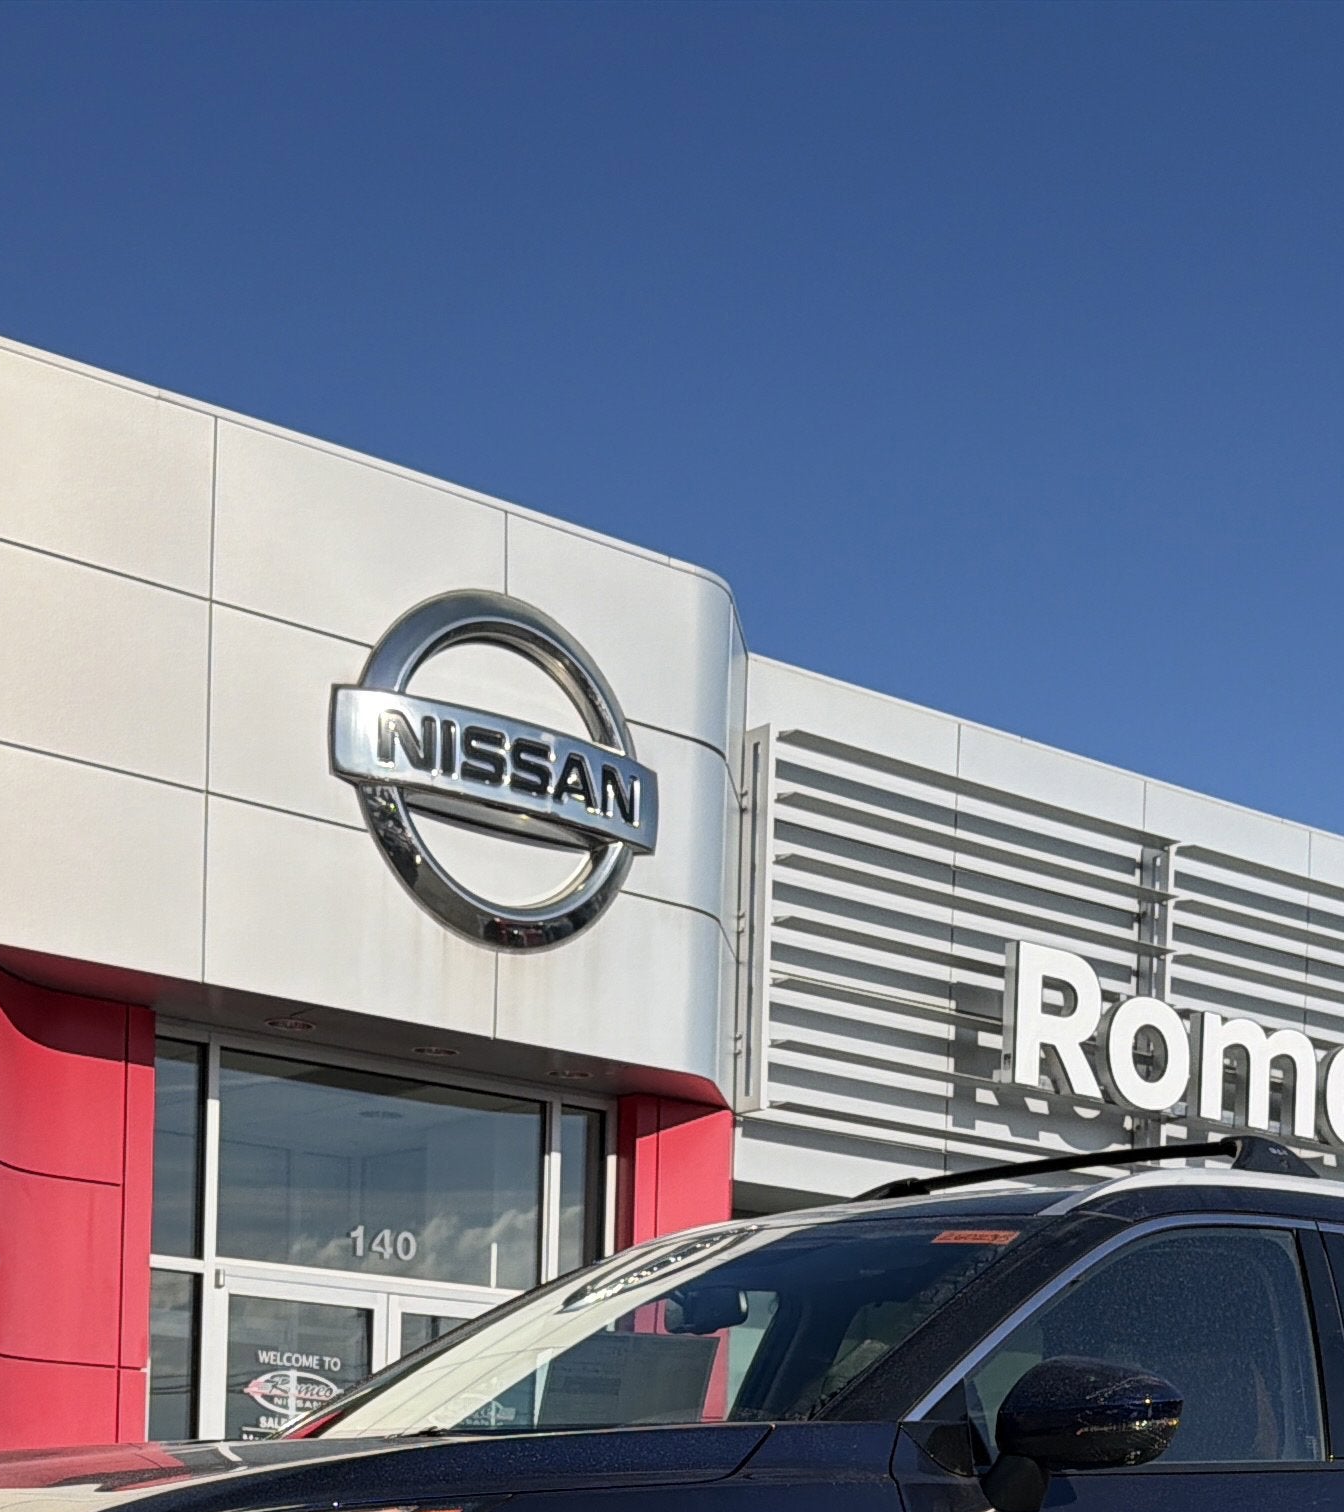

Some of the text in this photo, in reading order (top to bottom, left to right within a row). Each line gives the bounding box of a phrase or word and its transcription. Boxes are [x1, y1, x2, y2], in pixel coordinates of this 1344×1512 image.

[376, 707, 643, 829] NISSAN
[349, 1223, 418, 1261] 140
[257, 1350, 342, 1372] WELCOME TO
[266, 1375, 334, 1397] Rmeo
[273, 1396, 322, 1410] NISAN
